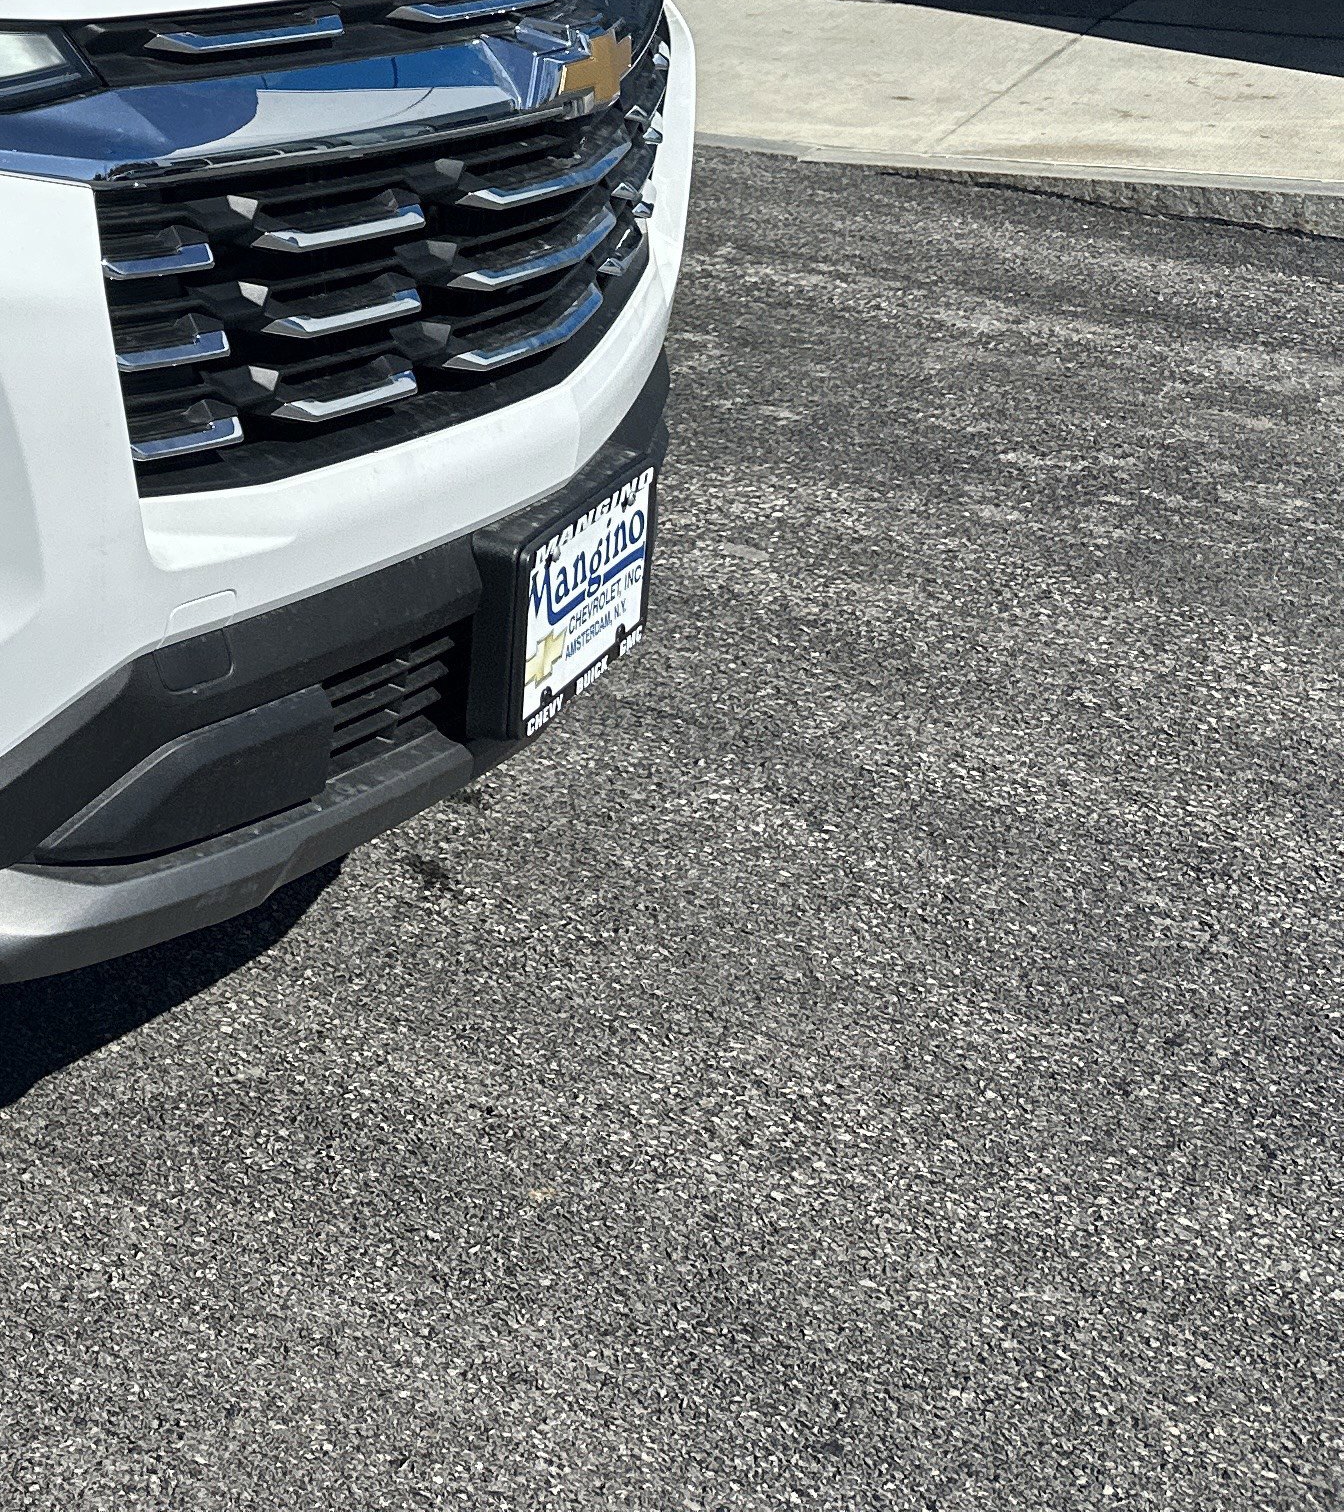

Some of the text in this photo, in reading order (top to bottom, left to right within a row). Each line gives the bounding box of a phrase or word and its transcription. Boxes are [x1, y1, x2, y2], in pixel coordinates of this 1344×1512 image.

[529, 509, 645, 626] Mangino
[534, 467, 654, 568] MANGINO
[526, 625, 643, 737] CHEVY BUICK GMC
